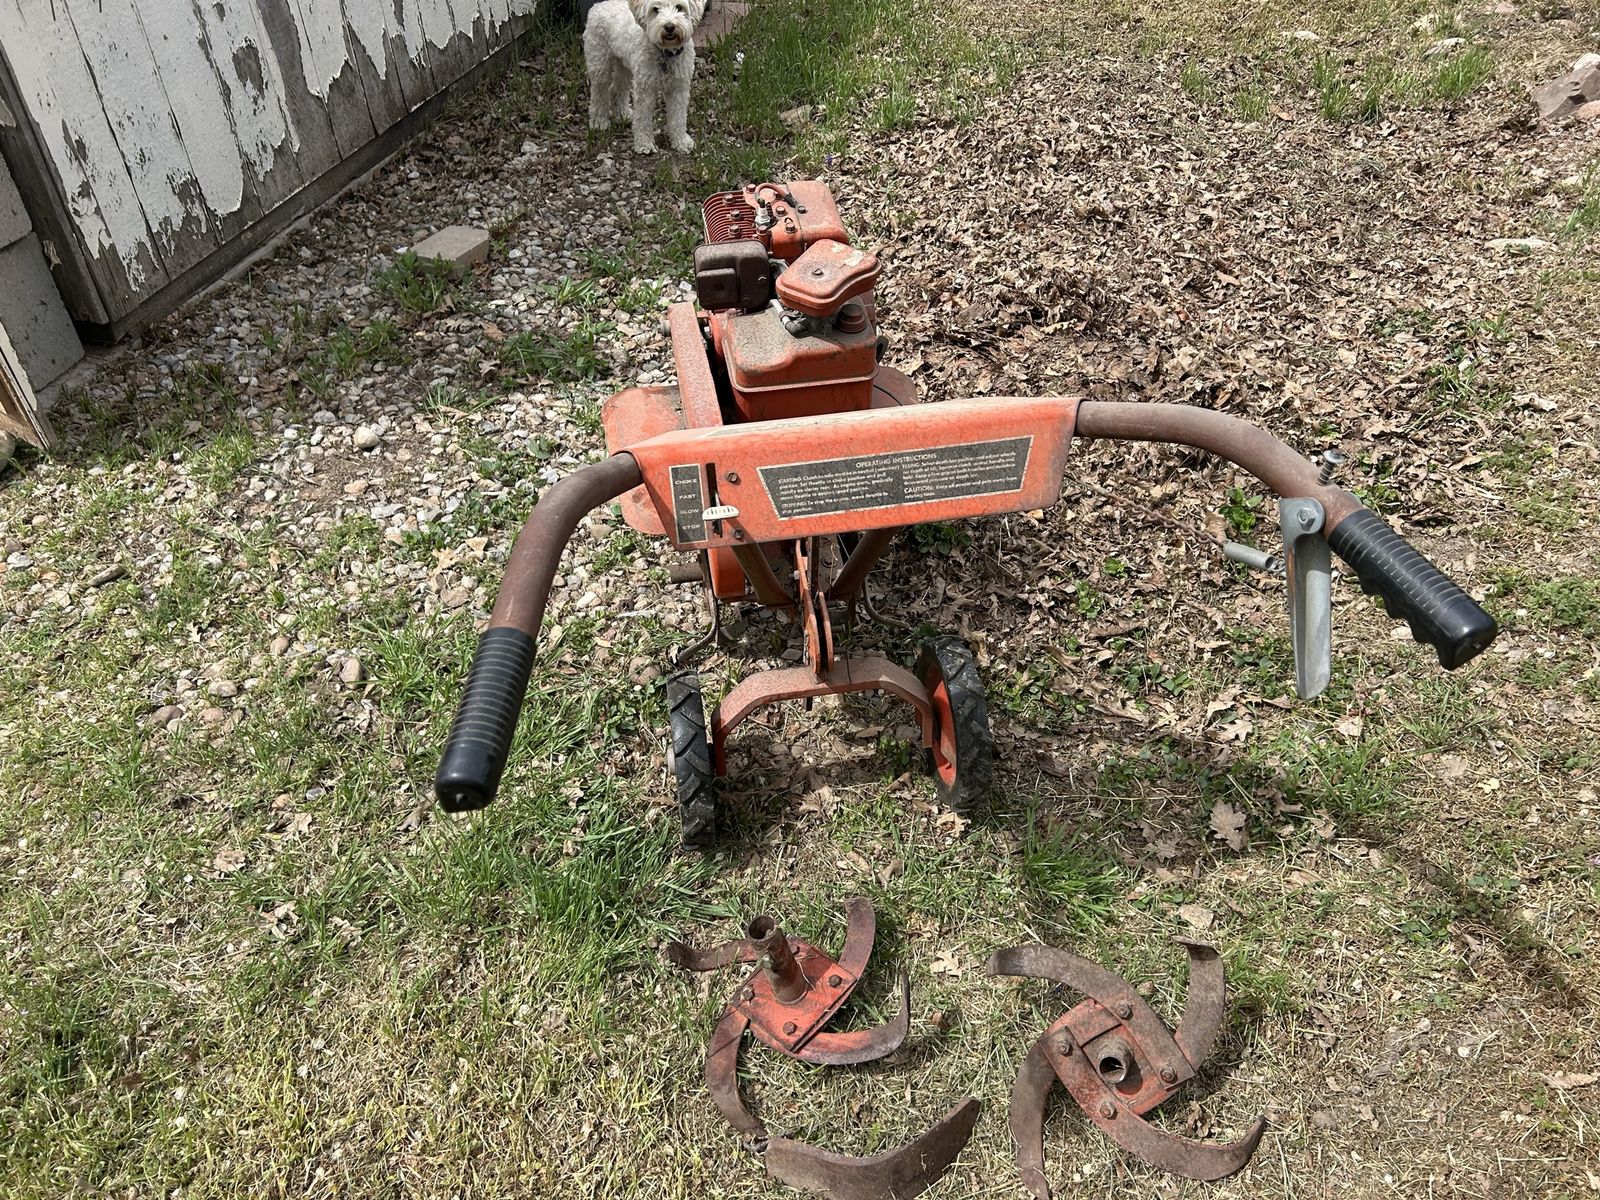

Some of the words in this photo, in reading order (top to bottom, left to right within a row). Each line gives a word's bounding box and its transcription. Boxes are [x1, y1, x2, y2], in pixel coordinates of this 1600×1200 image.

[855, 458, 890, 468] OPERATING
[892, 453, 936, 463] INSTRUCTIONS
[871, 477, 893, 485] gradually
[903, 485, 934, 493] CAUTION:
